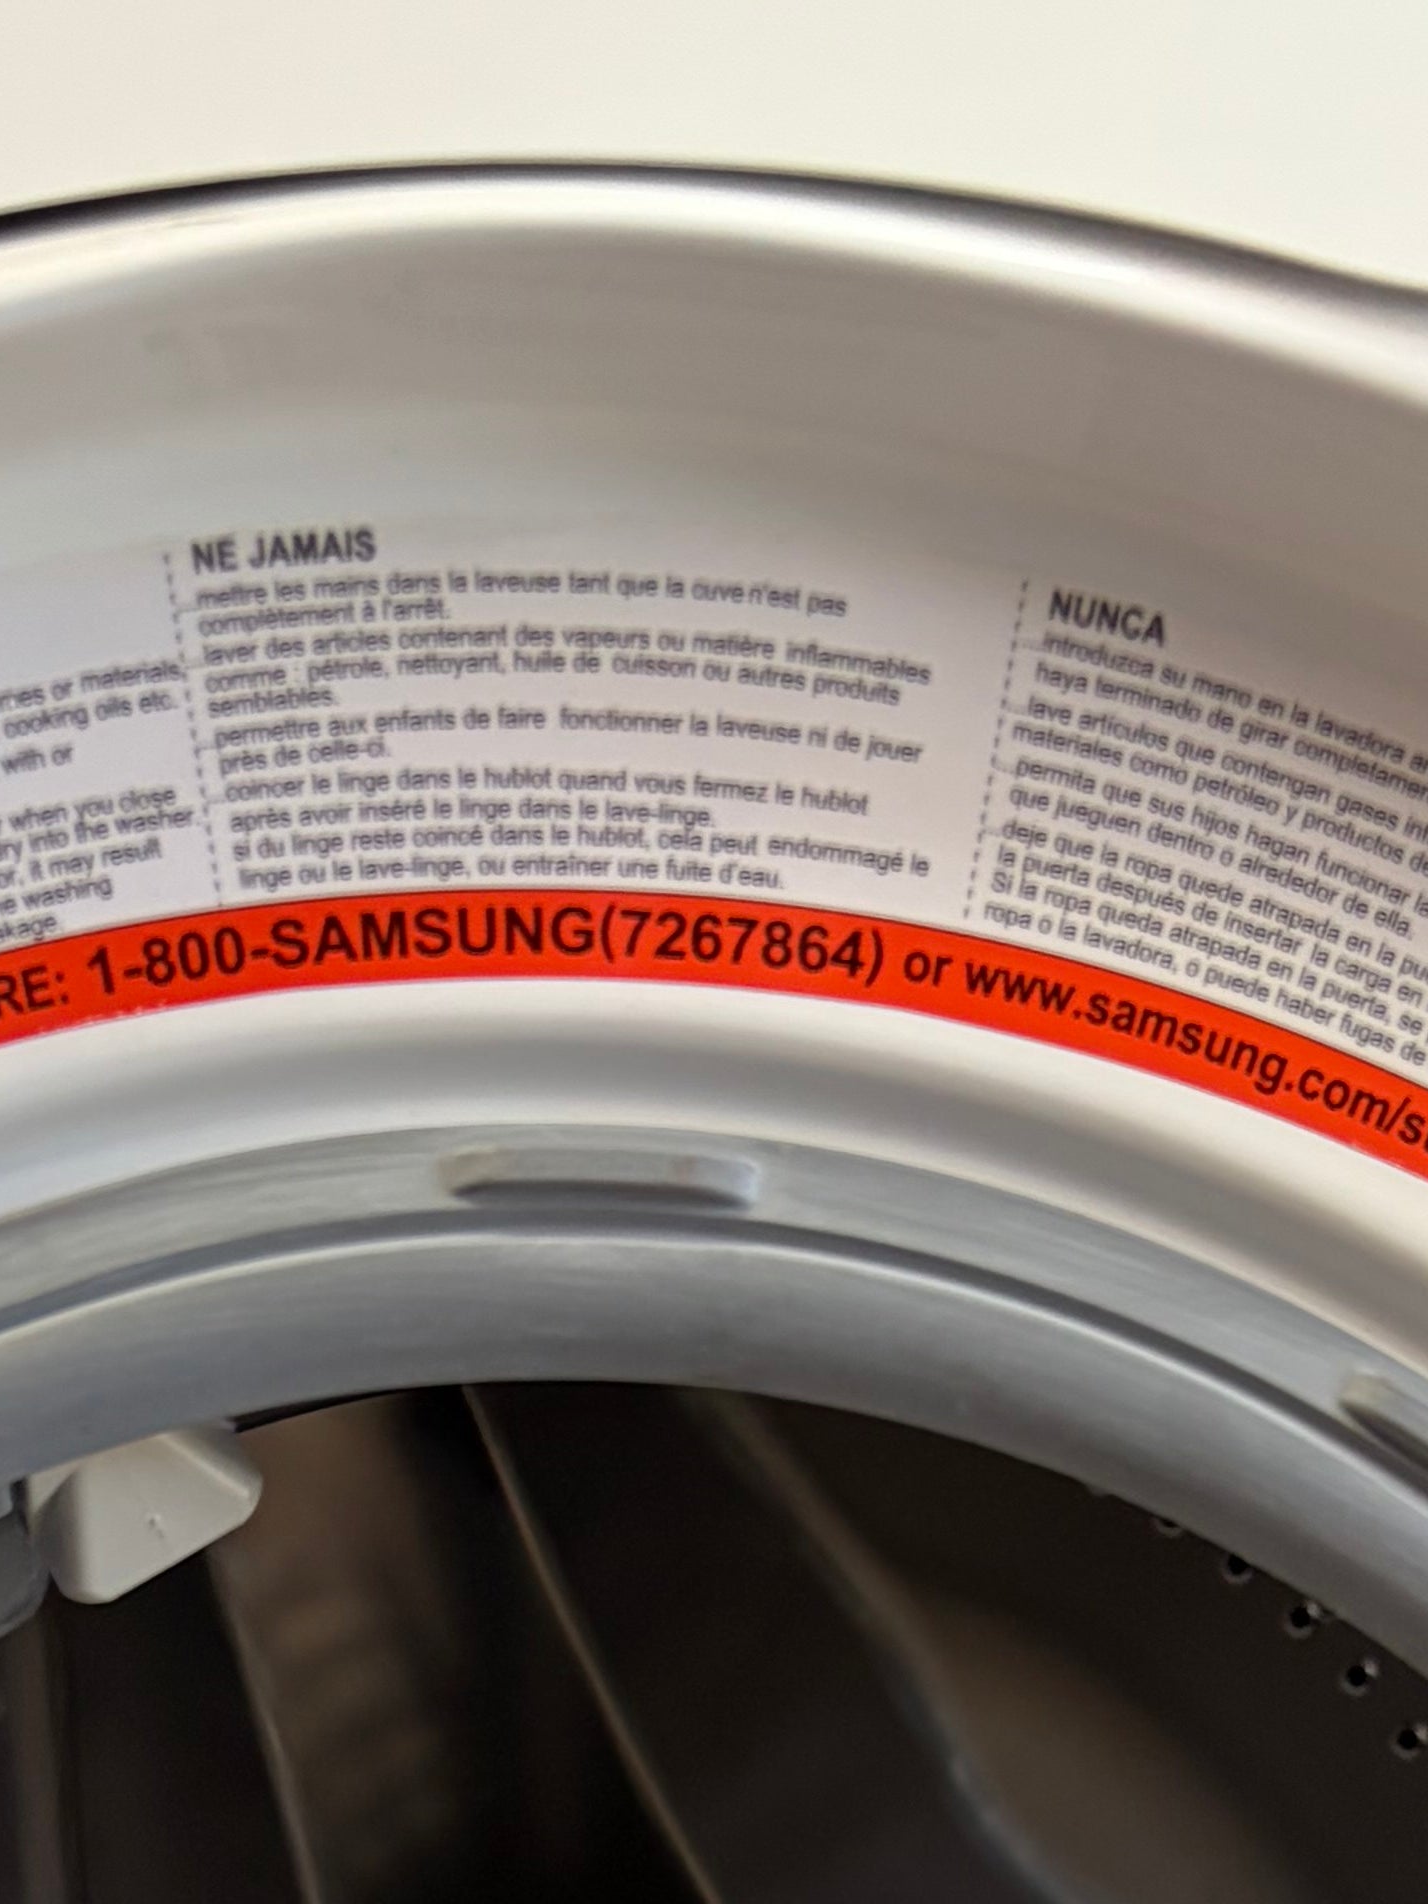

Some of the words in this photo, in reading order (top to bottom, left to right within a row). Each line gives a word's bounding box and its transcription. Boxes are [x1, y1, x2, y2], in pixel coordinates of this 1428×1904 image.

[190, 541, 238, 574] NE
[249, 530, 377, 569] JAMAIS
[1048, 588, 1165, 647] NUNCA
[1035, 660, 1089, 695] haya
[1094, 674, 1204, 723] terminado
[1206, 705, 1235, 734] de
[1238, 719, 1291, 750] girar
[238, 868, 293, 893] linge
[297, 865, 327, 885] ou
[331, 860, 354, 881] le
[477, 856, 506, 876] ou
[617, 859, 660, 880] une
[665, 857, 713, 883] fuite
[88, 905, 884, 994] 1-800-SAMSUNG(7267864)
[903, 951, 953, 986] or
